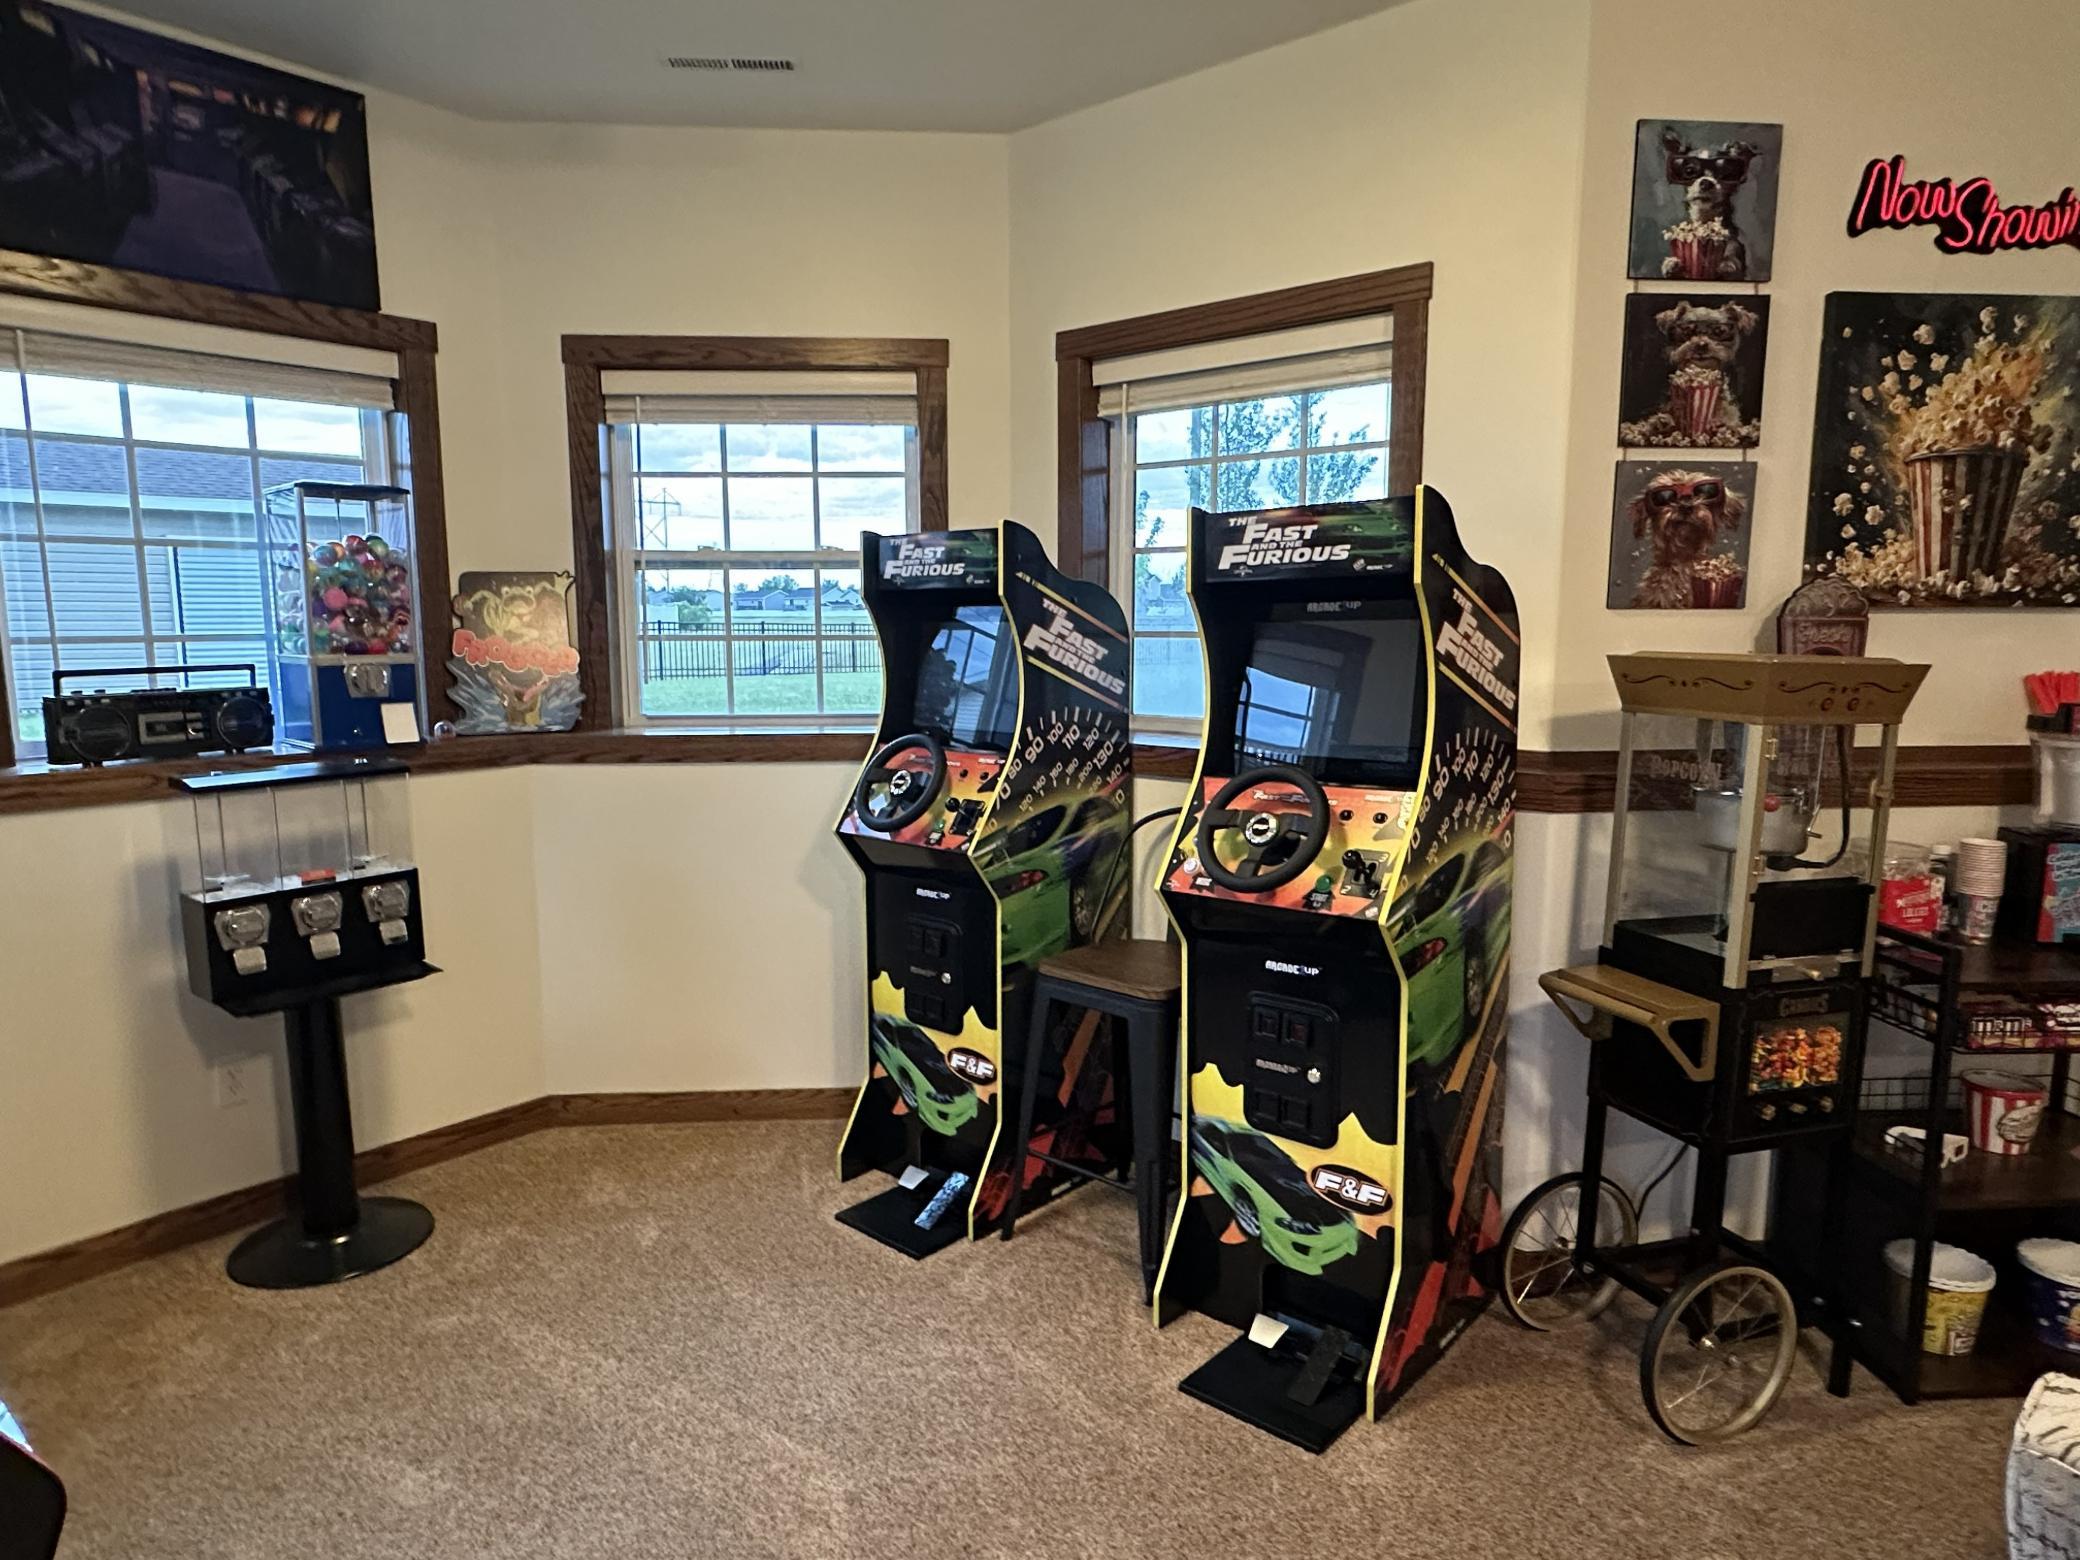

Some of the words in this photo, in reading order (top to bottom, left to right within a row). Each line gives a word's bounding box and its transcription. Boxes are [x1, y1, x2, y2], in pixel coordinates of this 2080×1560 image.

[1852, 156, 1957, 232] Now
[1228, 516, 1257, 527] THE
[1242, 523, 1318, 545] FAST
[898, 543, 945, 560] FAST
[1218, 544, 1351, 571] FURIOUS
[1252, 542, 1280, 551] AND
[1279, 540, 1304, 549] THE
[883, 562, 965, 579] FURIOUS
[1042, 597, 1068, 617] THE
[1452, 587, 1473, 614] THE
[1049, 614, 1109, 661] FAST
[1457, 609, 1505, 668] FAST
[1023, 623, 1126, 695] FURIOUS
[1435, 620, 1517, 710] FURIOUS
[1047, 722, 1064, 745] 100
[1062, 724, 1081, 750] 110
[1082, 727, 1099, 751] 120
[1025, 736, 1044, 763] 90
[1093, 740, 1114, 770] 130
[1007, 758, 1022, 780] 80
[1341, 885, 1351, 894] 2
[1369, 889, 1379, 898] 4
[950, 1053, 994, 1076] F&F
[1314, 1171, 1387, 1203] F&F
